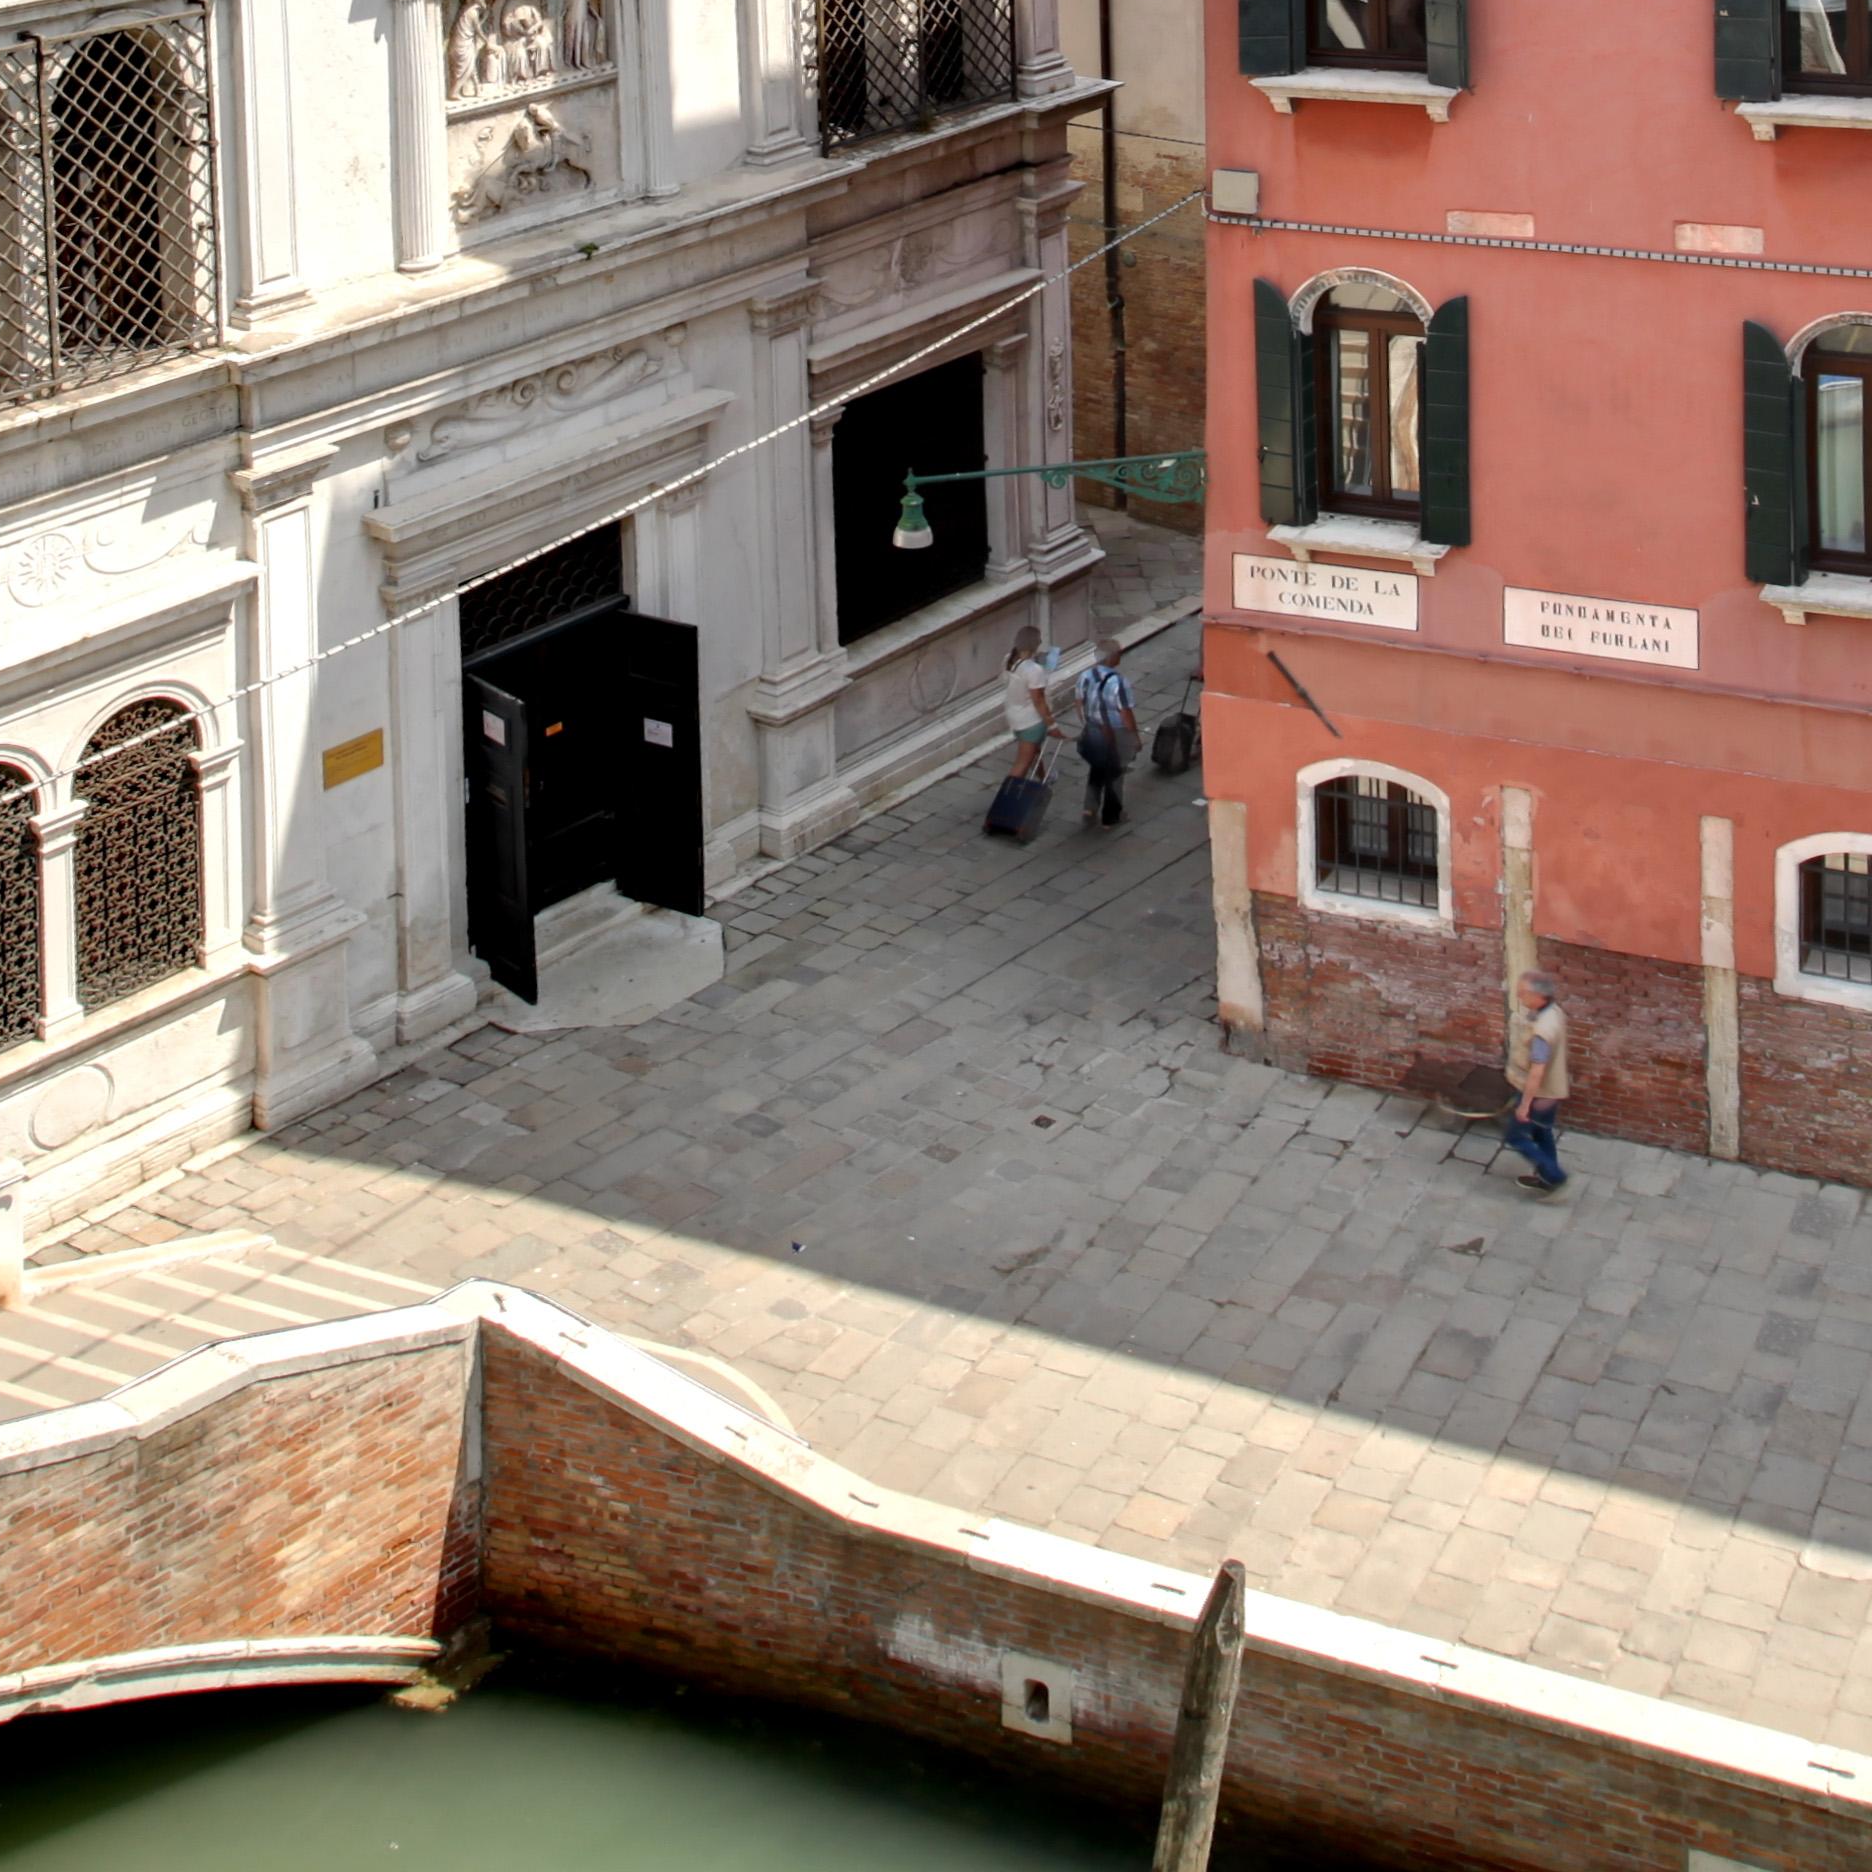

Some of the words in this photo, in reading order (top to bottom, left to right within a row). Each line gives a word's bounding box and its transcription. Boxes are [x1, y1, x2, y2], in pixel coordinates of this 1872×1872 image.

[1248, 564, 1317, 587] PONTE
[1331, 575, 1360, 592] DE
[1374, 579, 1401, 597] LA
[1278, 591, 1375, 616] COMENDA
[1540, 600, 1673, 630] FONDAMENTA
[1540, 624, 1573, 642] DEI
[1590, 631, 1671, 653] FURLANI
